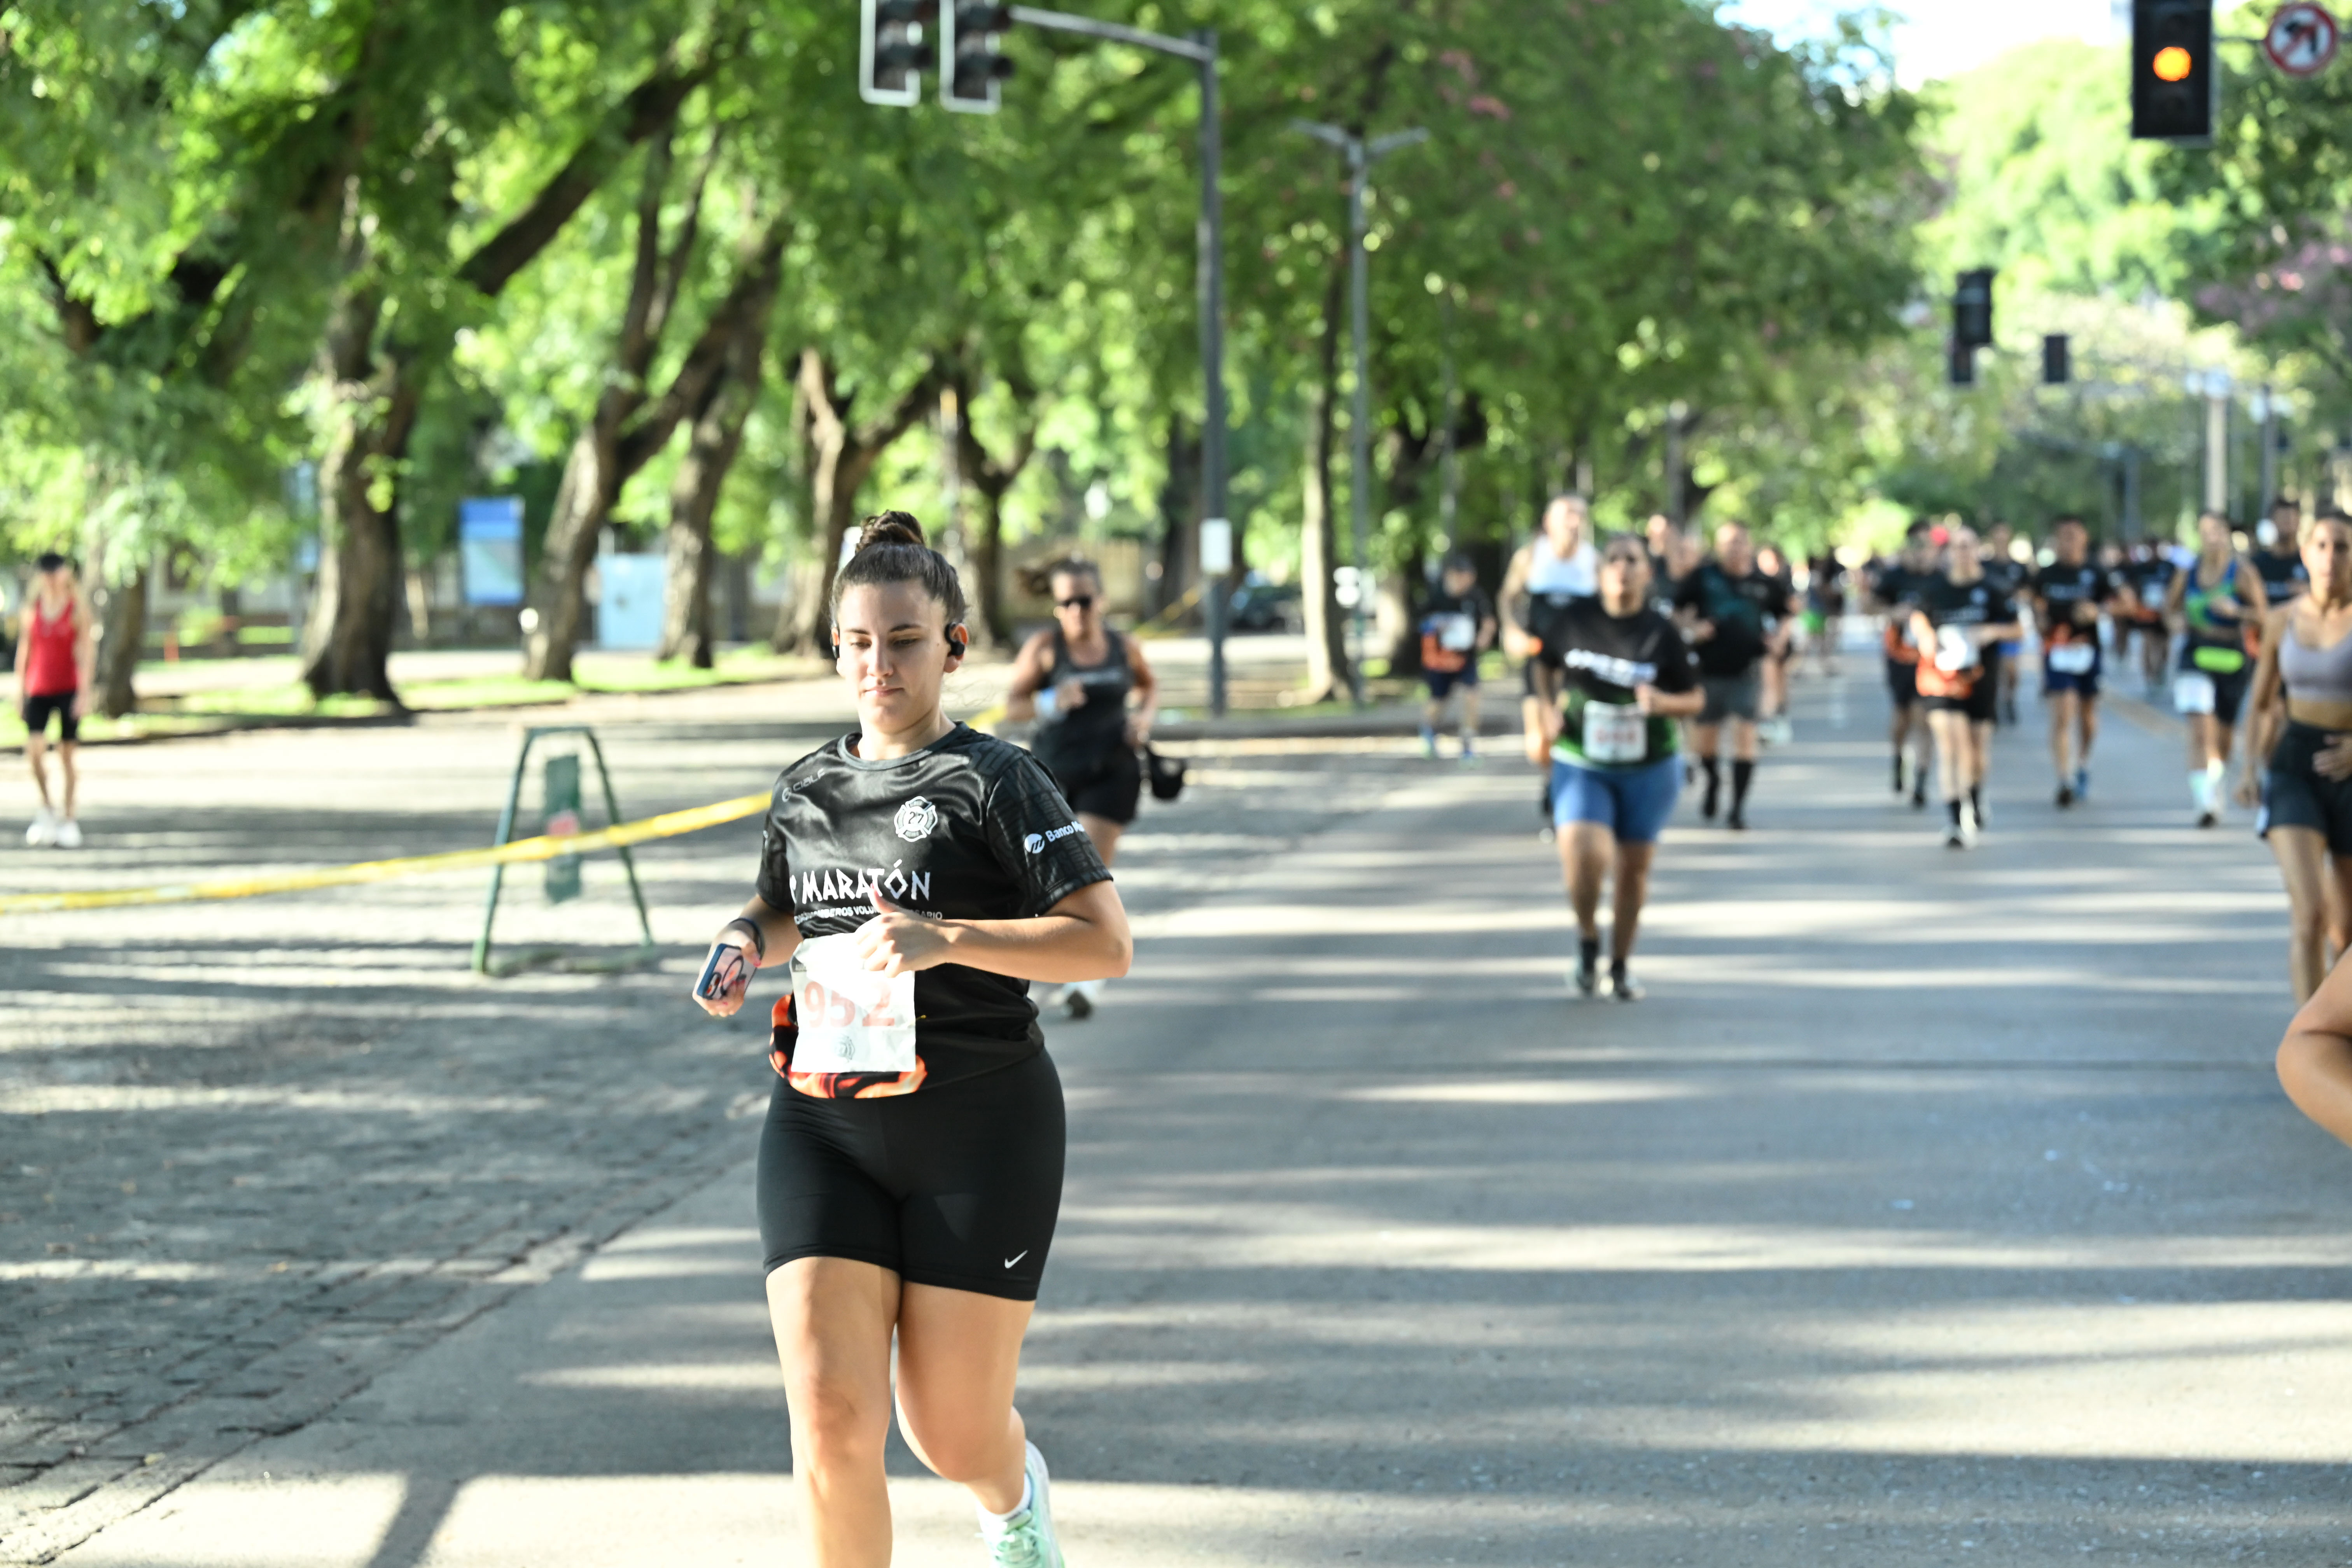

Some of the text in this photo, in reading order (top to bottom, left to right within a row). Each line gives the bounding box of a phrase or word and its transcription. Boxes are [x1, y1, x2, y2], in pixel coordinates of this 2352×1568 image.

[908, 811, 924, 824] 27
[1045, 825, 1074, 842] Banco
[802, 859, 930, 904] MARATÓN
[804, 981, 895, 1027] 952
